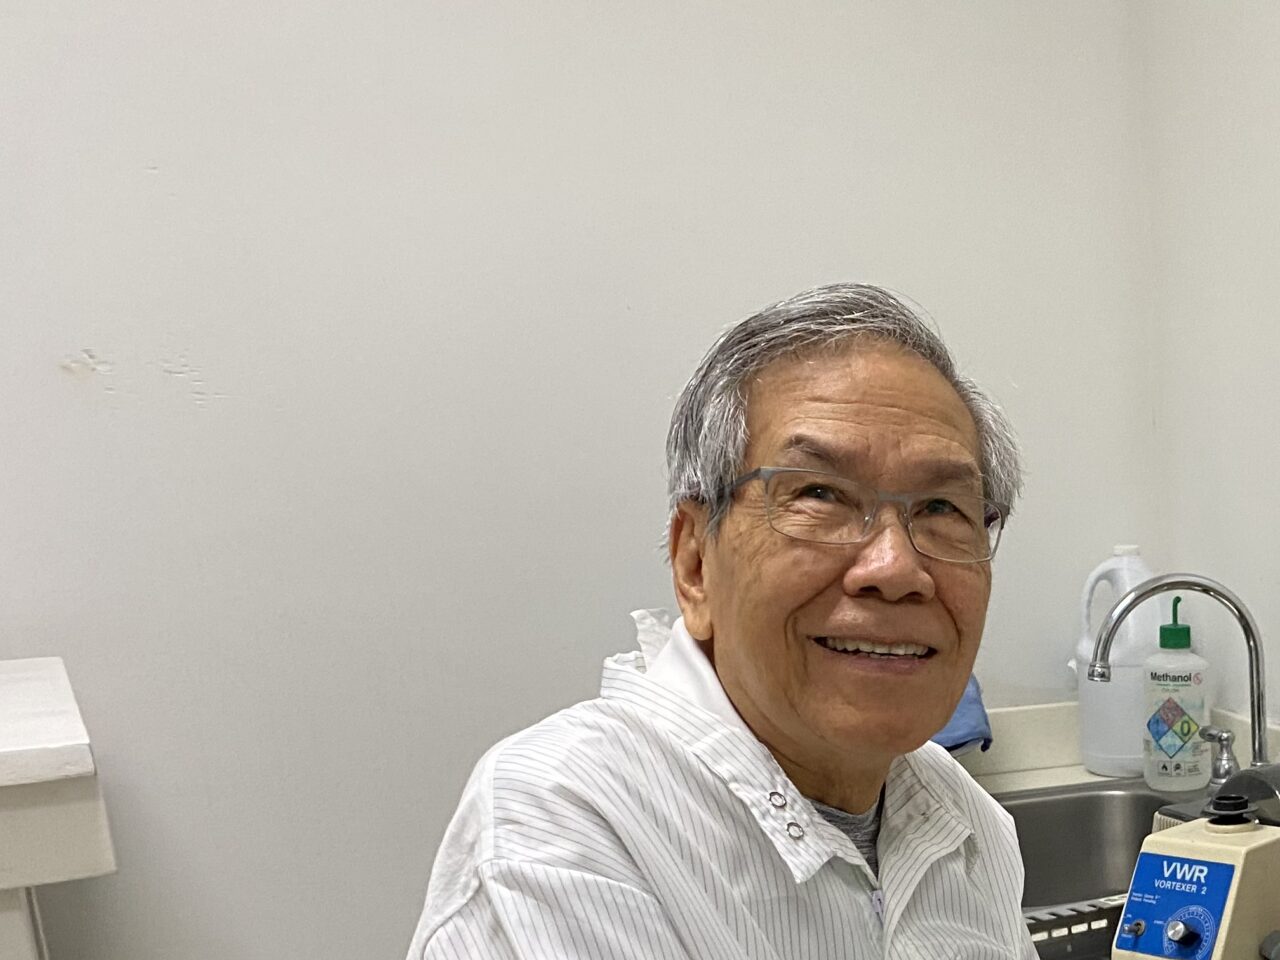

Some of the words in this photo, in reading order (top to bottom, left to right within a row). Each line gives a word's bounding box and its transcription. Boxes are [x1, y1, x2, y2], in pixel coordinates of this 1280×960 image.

[1150, 671, 1192, 683] Methanol
[1162, 860, 1209, 884] VWR
[1154, 879, 1198, 893] VORTEXER
[1200, 886, 1207, 895] 2
